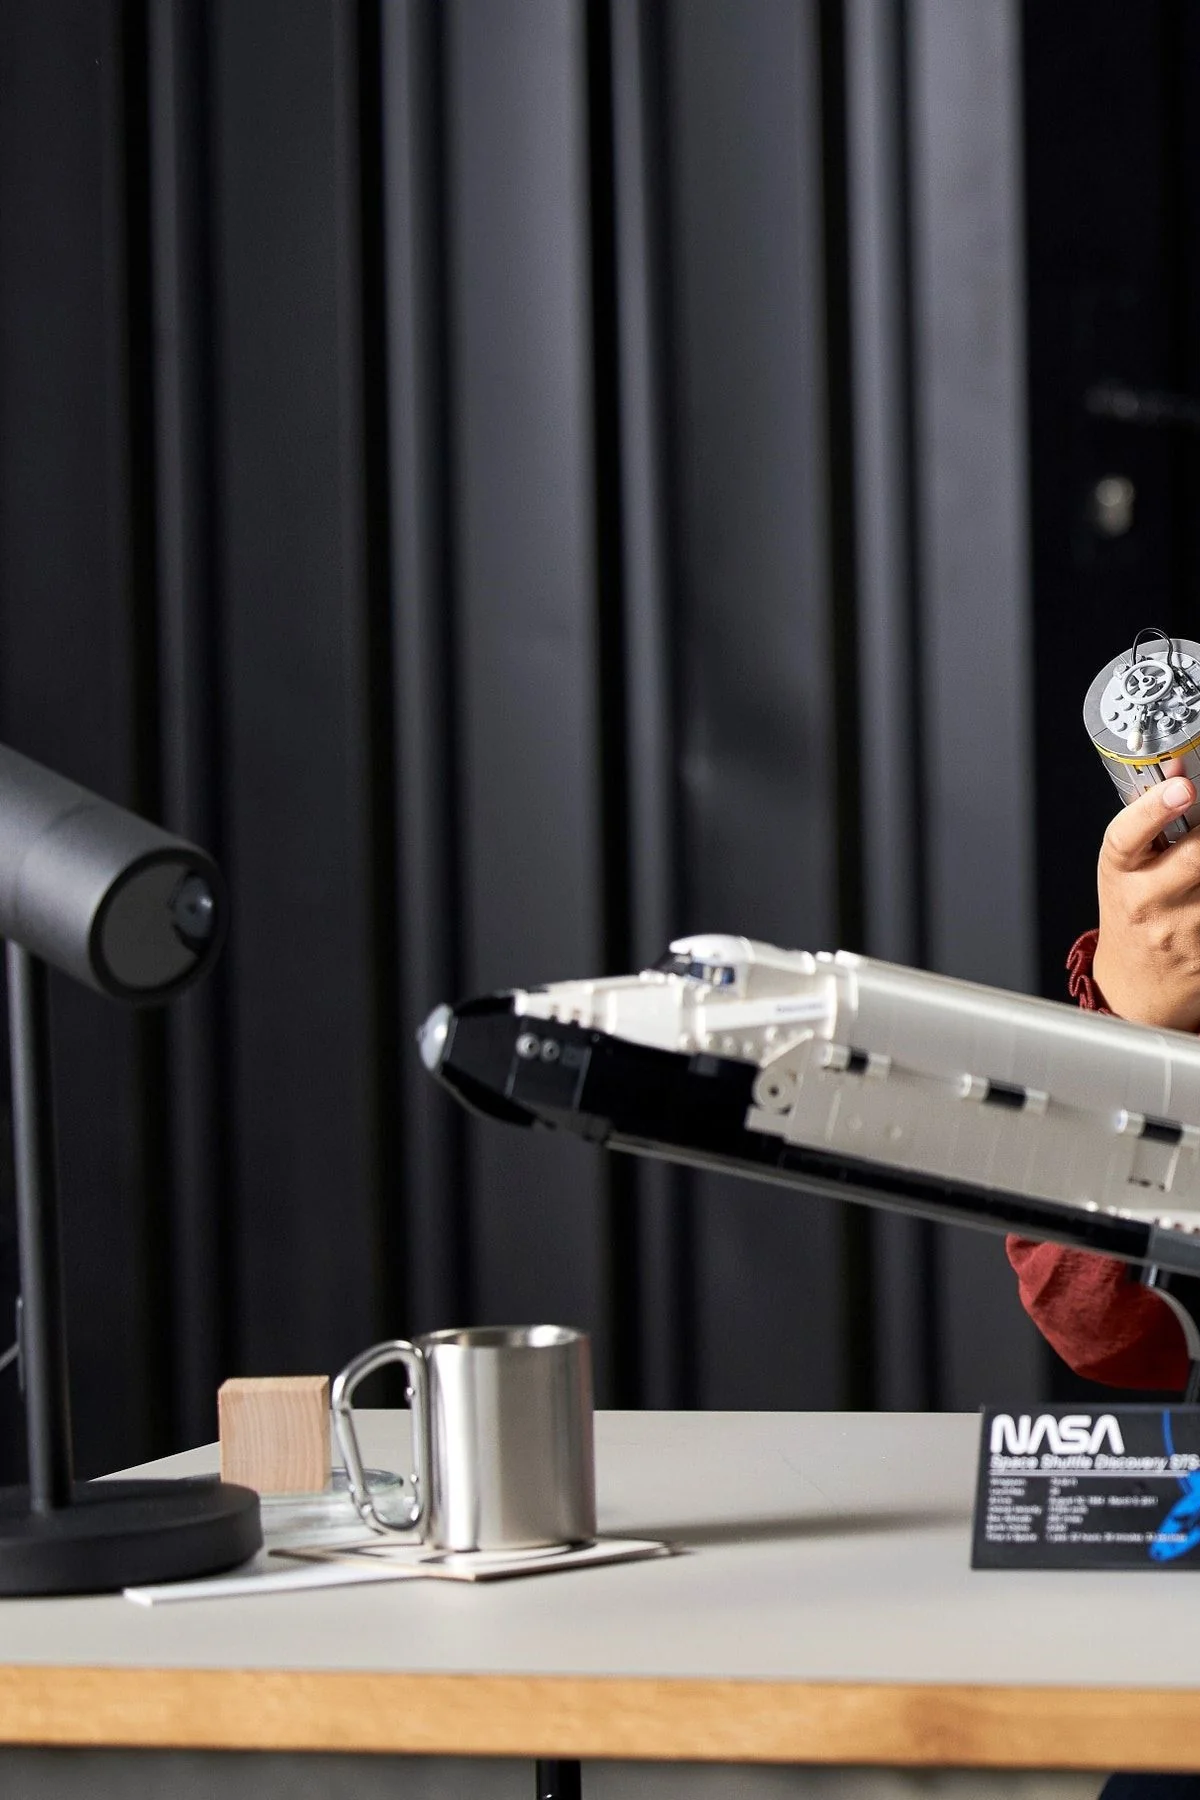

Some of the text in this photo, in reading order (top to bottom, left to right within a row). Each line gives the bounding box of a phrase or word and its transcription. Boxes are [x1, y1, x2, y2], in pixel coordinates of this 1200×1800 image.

[990, 1414, 1125, 1455] NASA
[990, 1453, 1039, 1471] Space
[1041, 1453, 1093, 1469] Shuttle
[1094, 1453, 1168, 1471] Discovery
